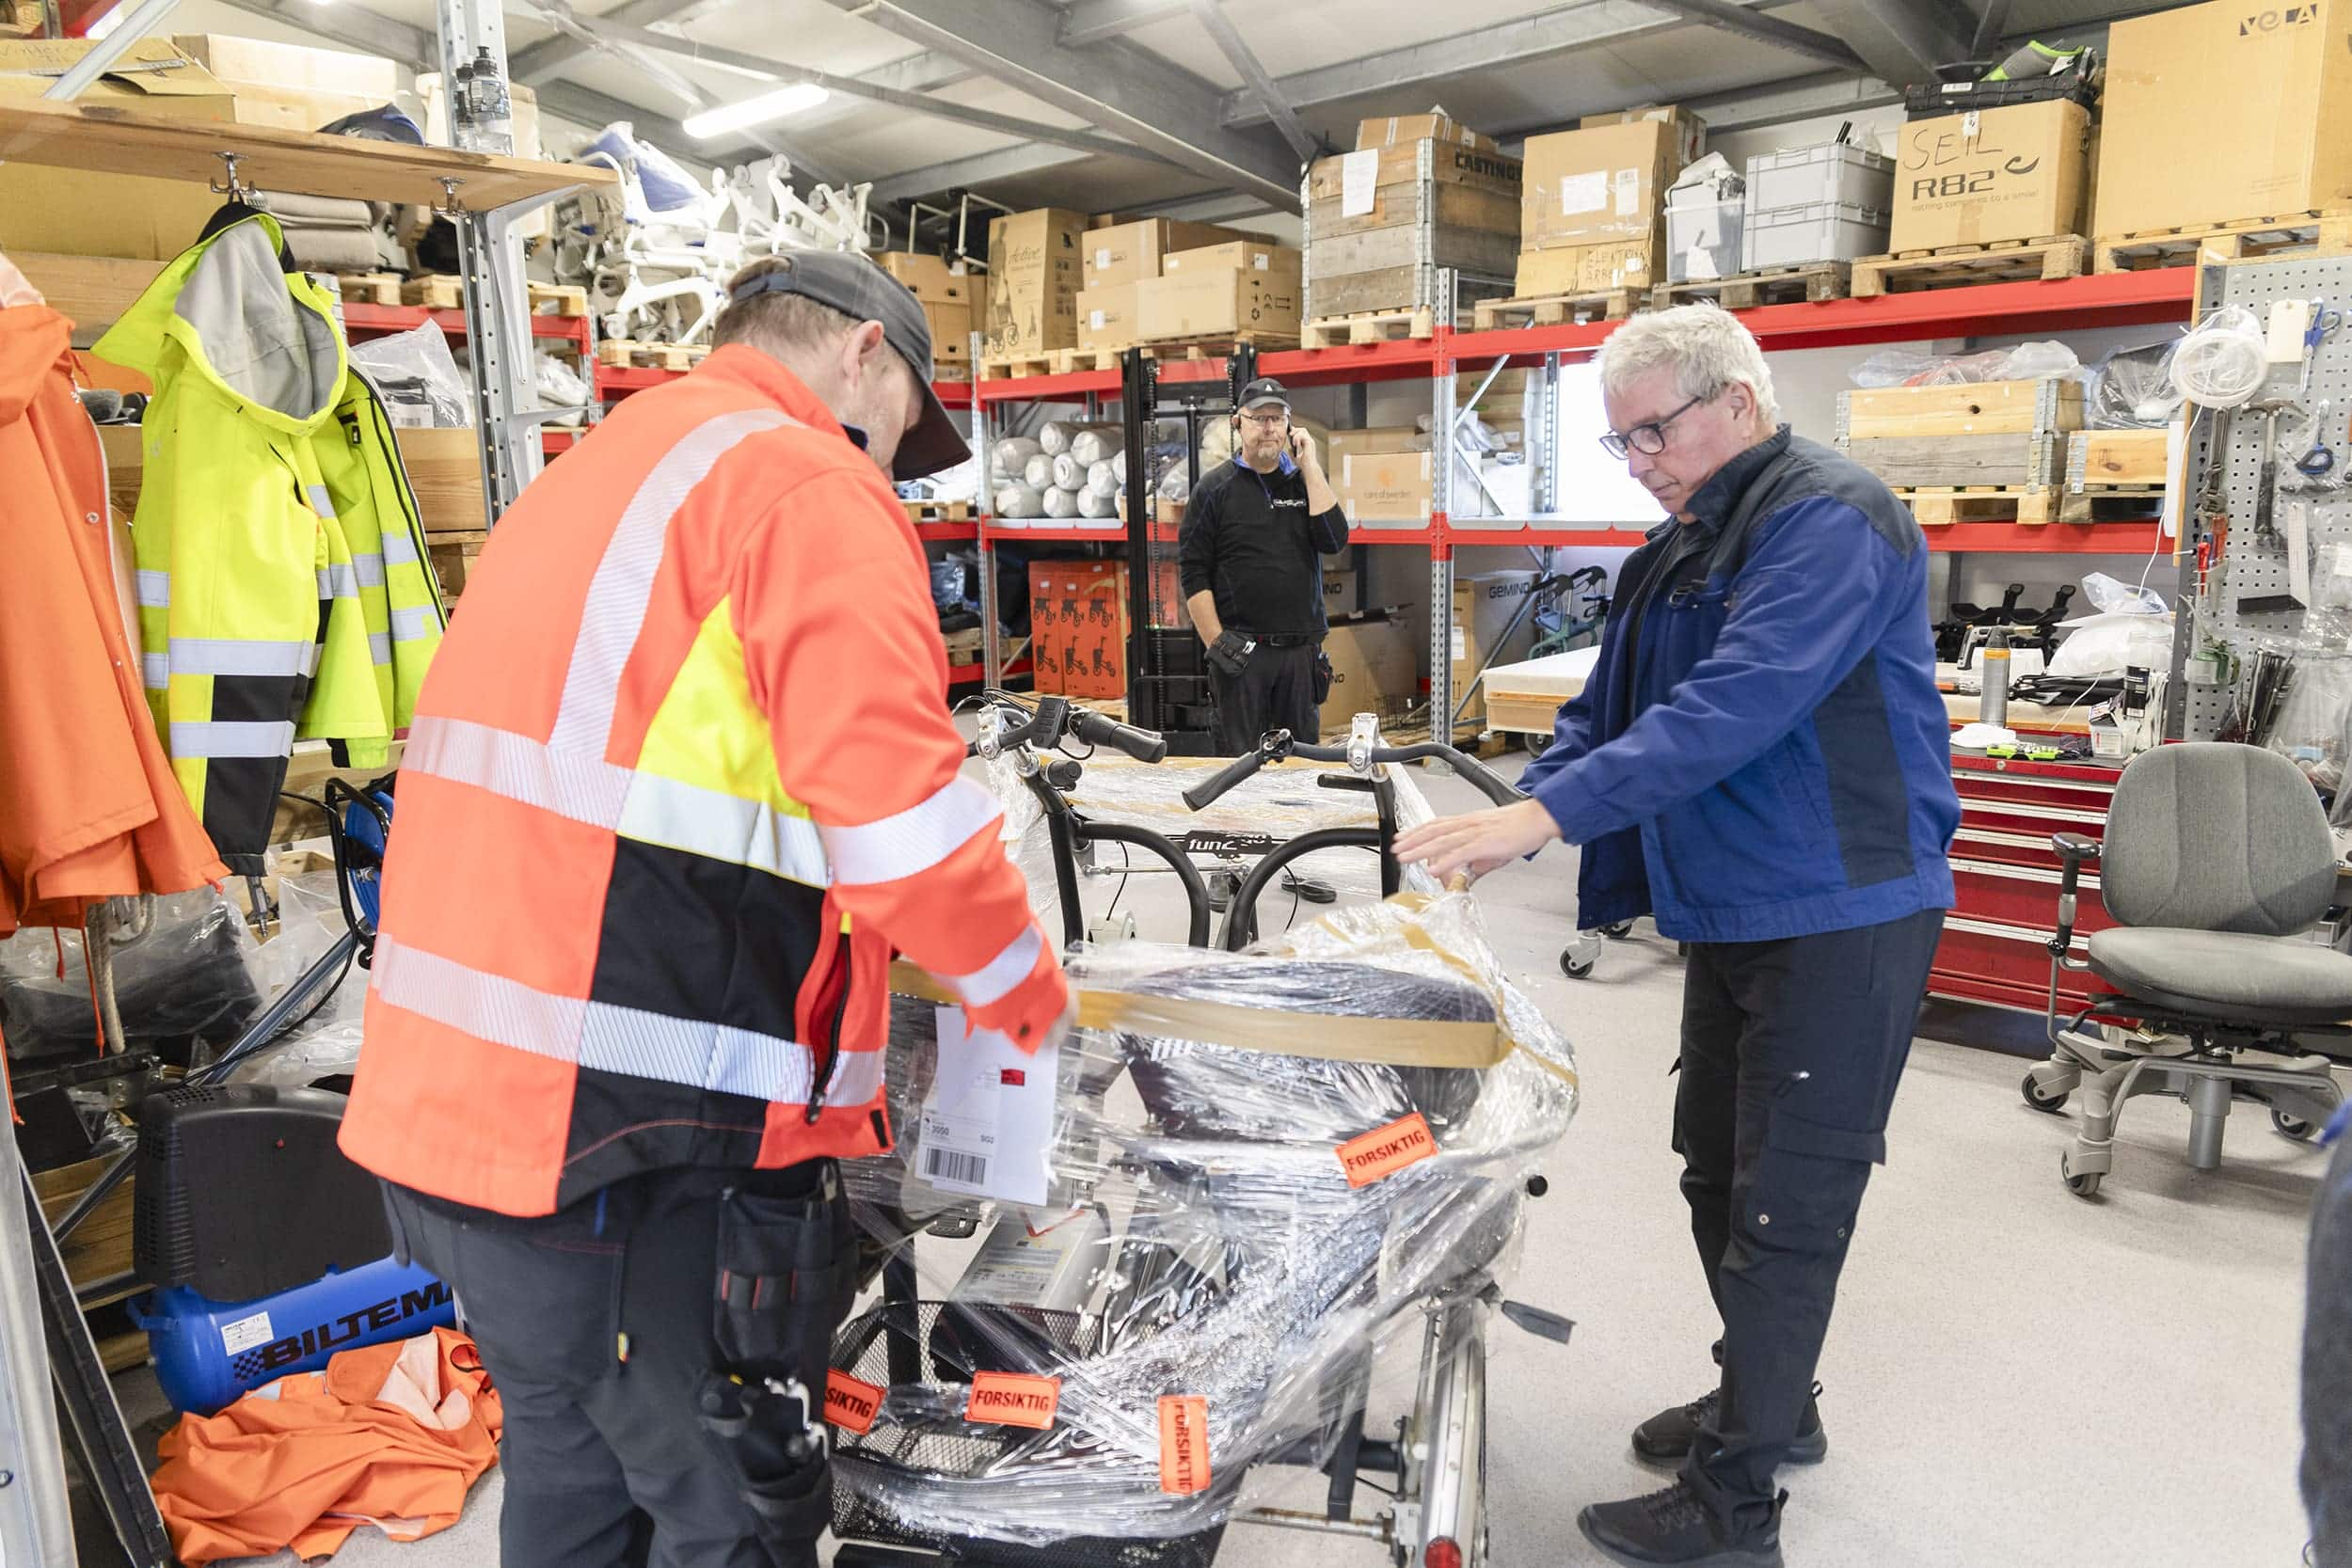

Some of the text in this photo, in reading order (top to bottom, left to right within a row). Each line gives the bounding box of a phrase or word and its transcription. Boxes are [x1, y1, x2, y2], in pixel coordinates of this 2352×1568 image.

[1913, 170, 1995, 200] R82
[1324, 583, 1342, 595] INO
[1346, 1131, 1425, 1171] FORSIKTIG
[262, 1280, 453, 1370] BILTEM
[825, 1387, 873, 1418] SIKTIG
[975, 1389, 1050, 1411] FORSIKTIG
